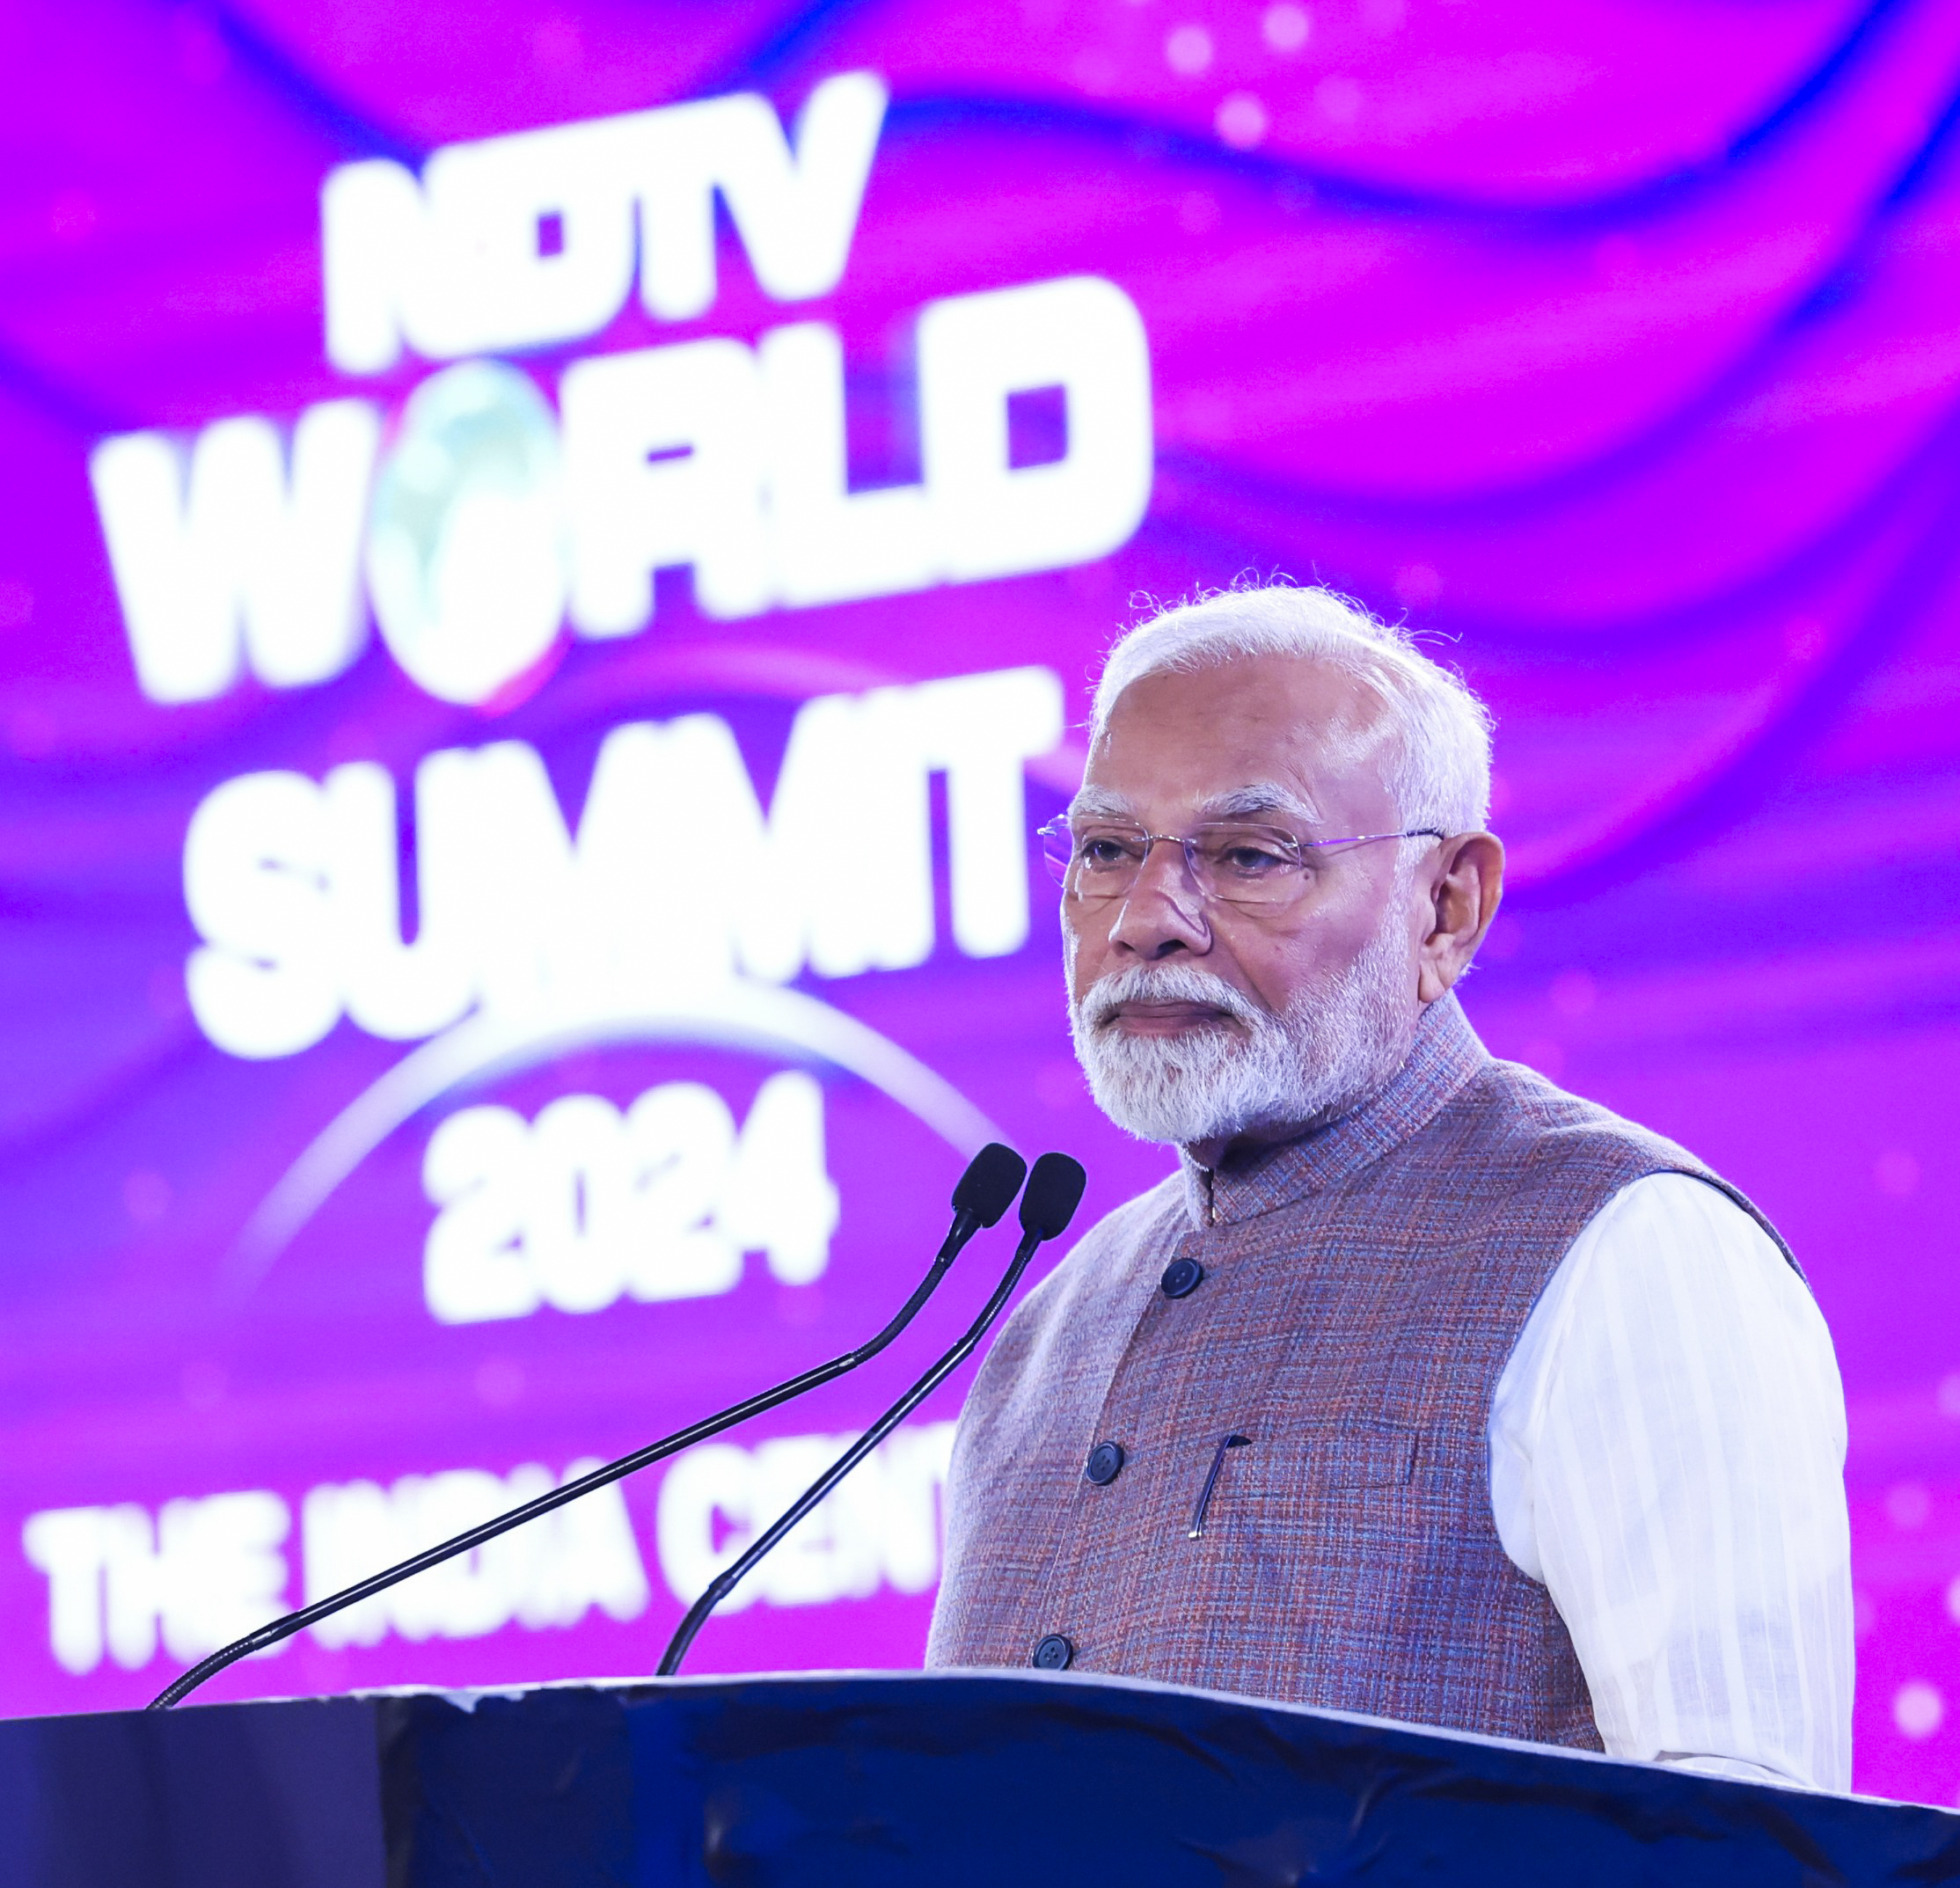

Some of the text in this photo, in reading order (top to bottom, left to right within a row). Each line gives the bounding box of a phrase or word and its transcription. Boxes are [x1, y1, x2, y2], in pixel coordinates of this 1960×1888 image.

[322, 70, 888, 376] NDTV
[90, 277, 1152, 706] WORLD
[184, 666, 1062, 1058] SUMMIT
[422, 1071, 838, 1324] 2024
[24, 1489, 293, 1674] THE
[302, 1458, 649, 1650] INDIA
